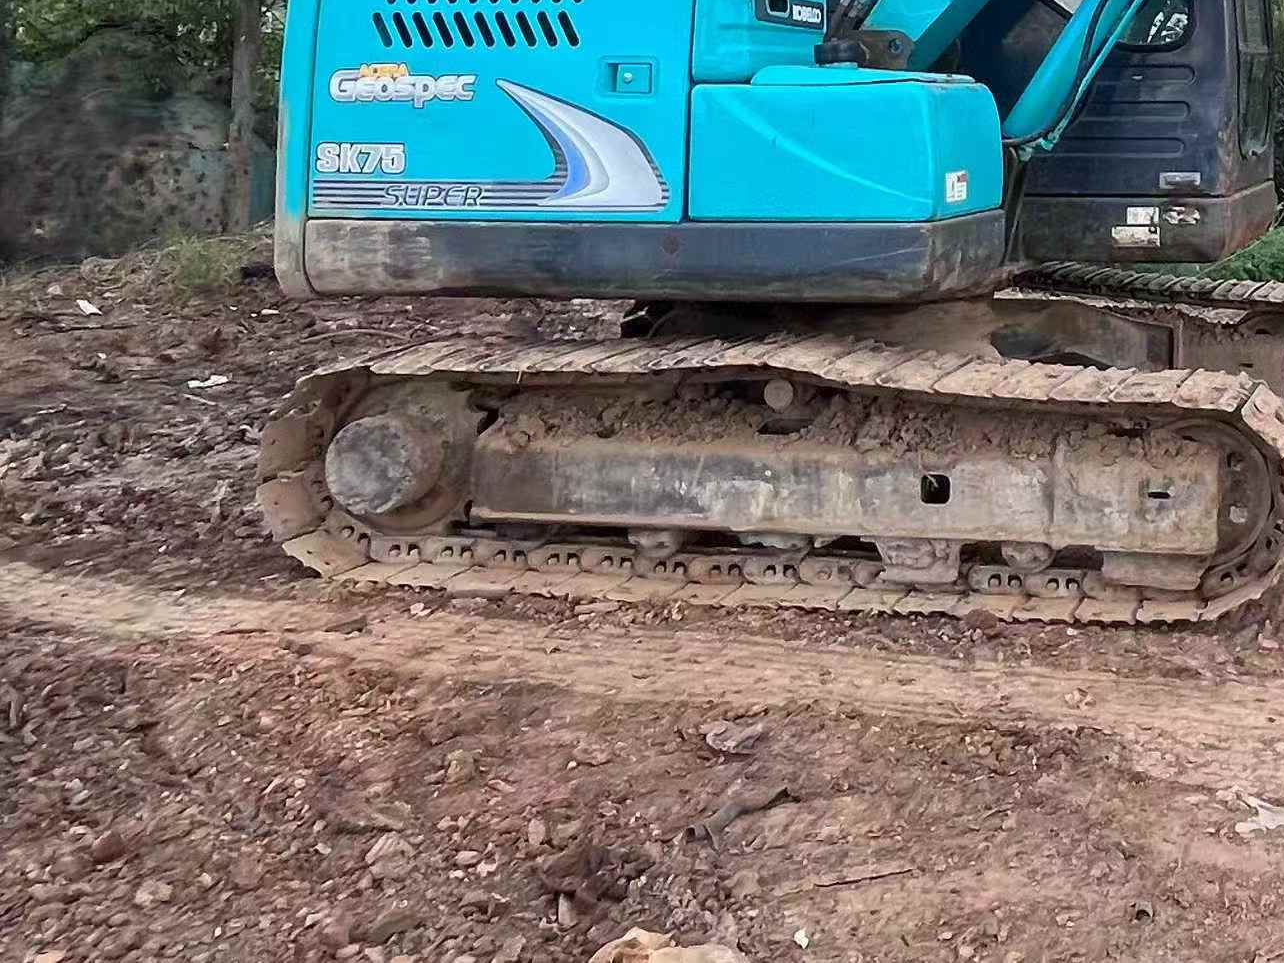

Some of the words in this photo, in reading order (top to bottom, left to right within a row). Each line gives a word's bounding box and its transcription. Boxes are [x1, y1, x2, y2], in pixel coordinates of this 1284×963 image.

[330, 69, 476, 108] Geospec
[316, 142, 405, 173] SK75
[383, 185, 483, 206] SUPER
